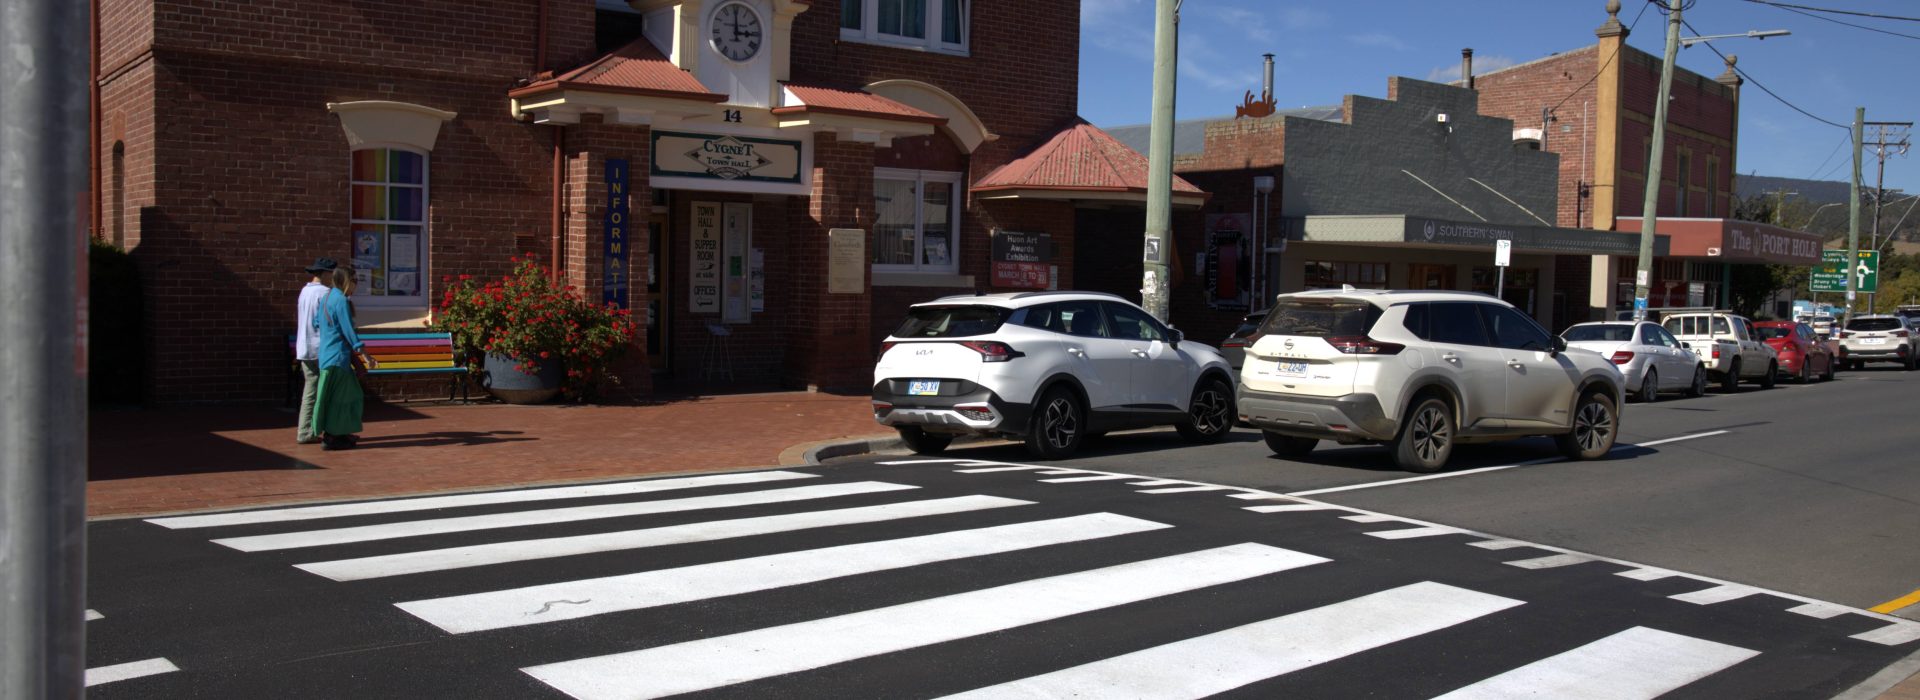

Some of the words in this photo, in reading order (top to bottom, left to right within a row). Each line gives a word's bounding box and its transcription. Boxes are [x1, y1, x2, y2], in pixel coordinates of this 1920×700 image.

[723, 109, 743, 123] 14
[703, 140, 754, 156] CYGNET
[696, 206, 715, 216] TOWN
[697, 217, 714, 228] HALL
[702, 229, 709, 238] &
[1439, 224, 1486, 239] SOUTHERN
[1489, 229, 1514, 240] SWAN
[694, 239, 717, 250] SUPPER
[1007, 234, 1025, 244] Huon
[1026, 236, 1038, 244] Art
[1731, 229, 1751, 250] The
[1762, 234, 1790, 255] PORT
[1792, 238, 1817, 258] HOLE
[1010, 245, 1035, 253] Awards
[696, 250, 715, 261] ROOM
[1005, 253, 1039, 262] Exhibition
[694, 286, 716, 296] OFFICES
